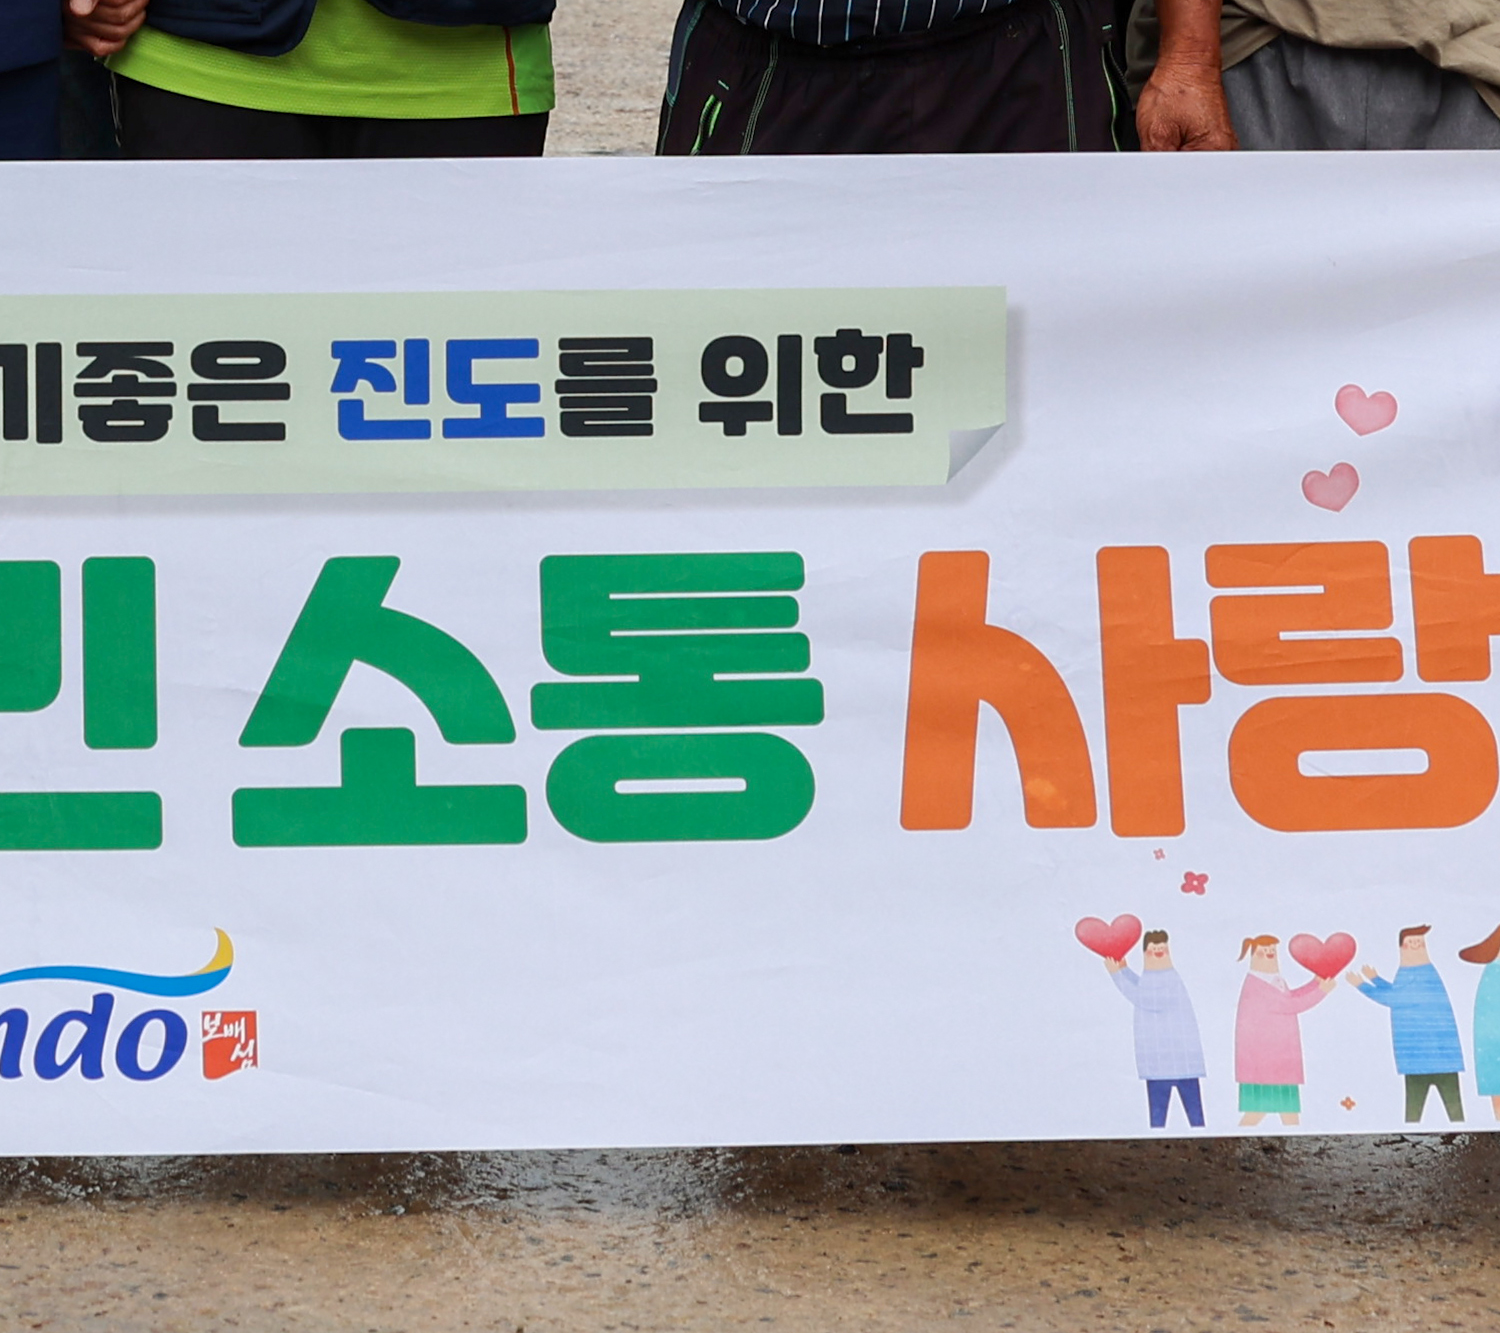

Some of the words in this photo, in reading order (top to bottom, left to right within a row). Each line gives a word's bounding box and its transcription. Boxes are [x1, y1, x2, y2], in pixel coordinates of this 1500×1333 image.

[331, 335, 657, 440] 진도를
[698, 328, 924, 434] 위한
[232, 551, 823, 846] 소통
